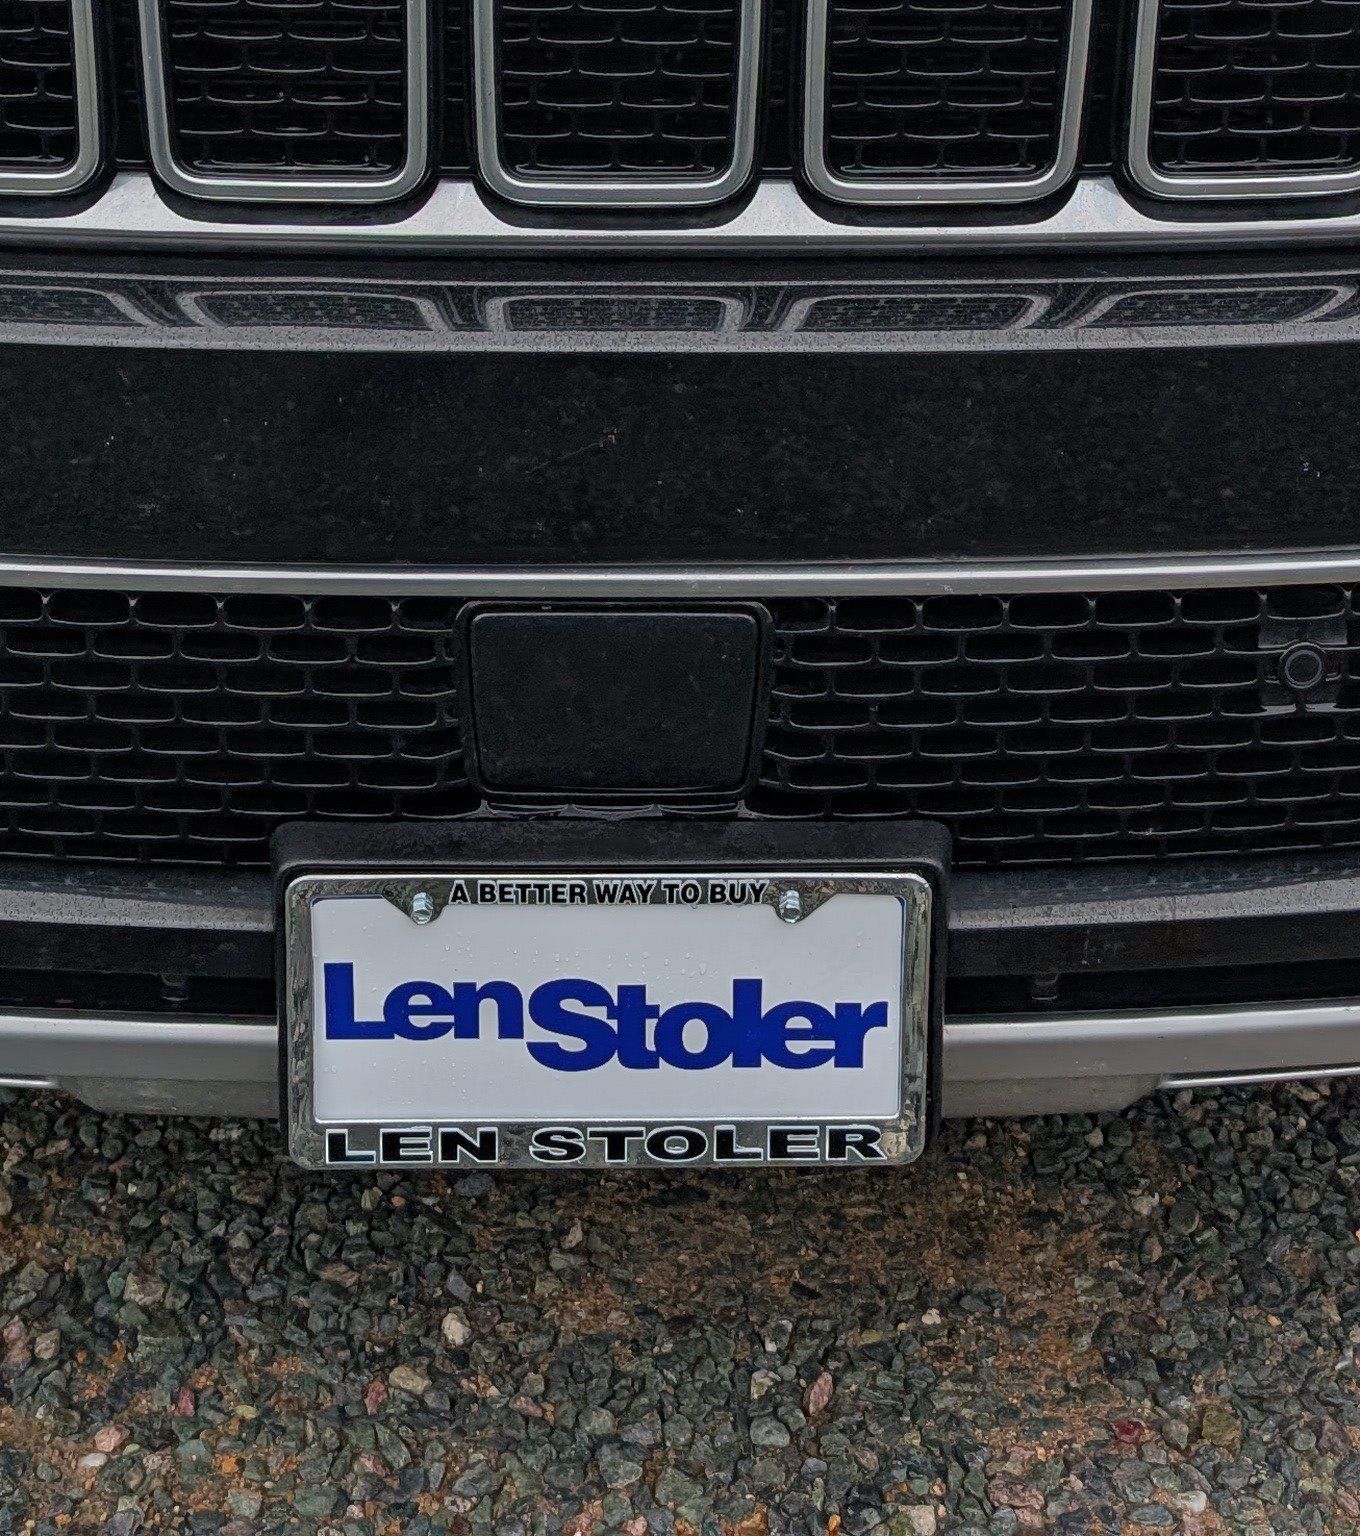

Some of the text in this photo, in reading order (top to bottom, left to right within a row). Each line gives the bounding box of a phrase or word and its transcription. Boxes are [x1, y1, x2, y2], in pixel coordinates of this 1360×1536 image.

[451, 880, 768, 905] A BETTER WAY TO BUY
[325, 1125, 887, 1164] LEN STOLER
